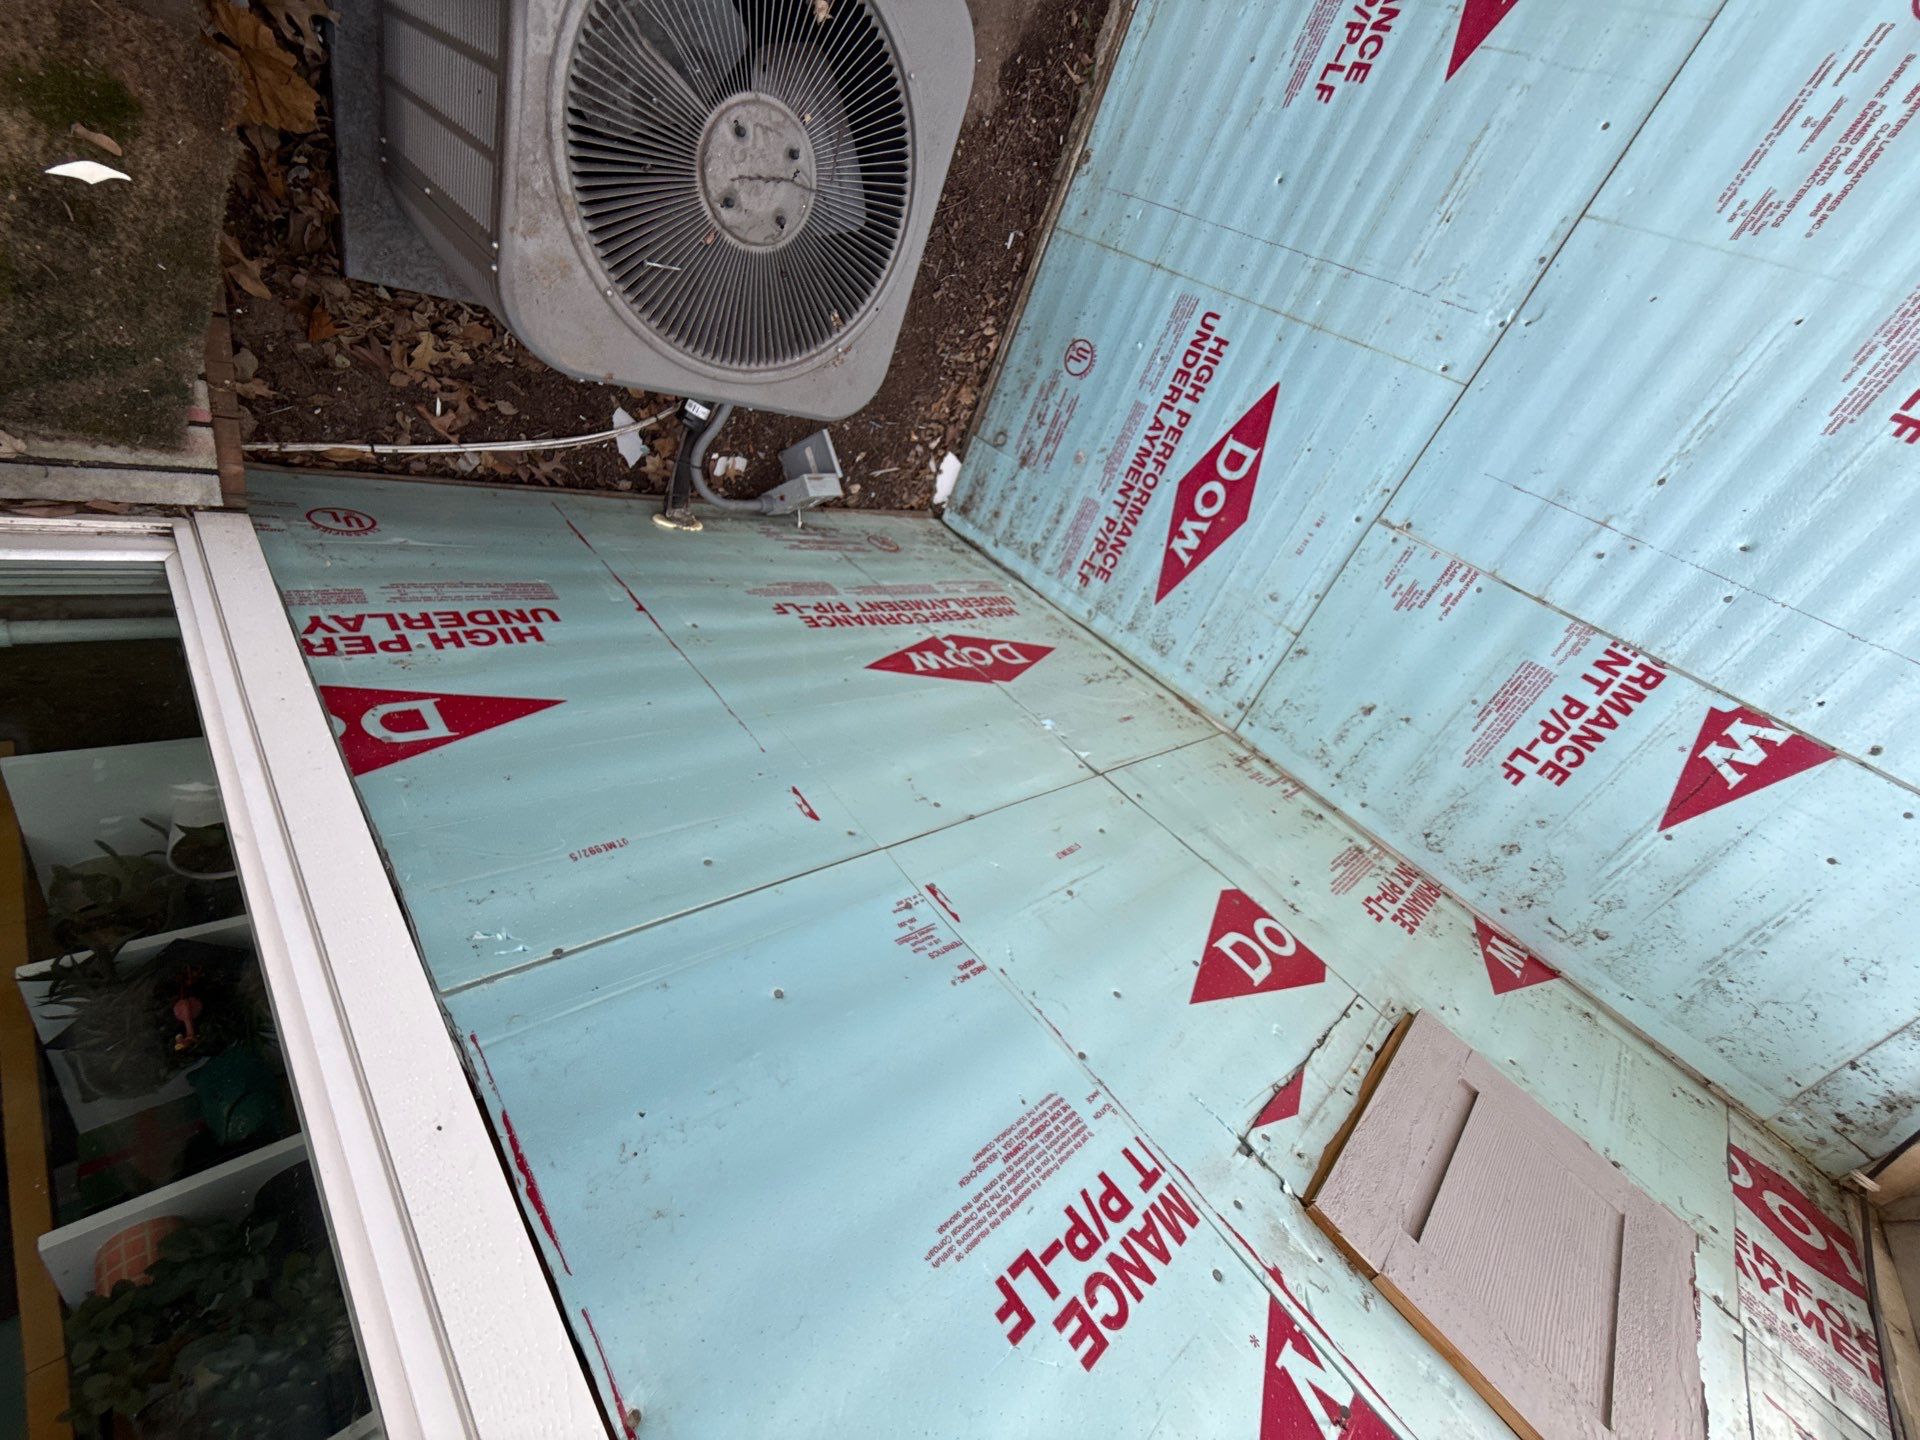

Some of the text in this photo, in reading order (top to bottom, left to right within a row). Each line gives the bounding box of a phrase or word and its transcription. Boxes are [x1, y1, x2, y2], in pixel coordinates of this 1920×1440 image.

[1344, 0, 1401, 83] NCE
[1814, 104, 1888, 186] FOAMED PLASTIC
[1841, 123, 1892, 175] CLASSIFIED
[1769, 145, 1843, 228] CHARACTERISTICS
[1183, 335, 1229, 403] HIGH
[1111, 310, 1220, 511] UNDERLAYMENT
[1889, 388, 1920, 444] F
[1093, 408, 1192, 583] PERFORMANCE
[1169, 433, 1262, 569] DOW
[1074, 515, 1119, 587] P/P-LF
[300, 607, 562, 636] UNDERLAY
[300, 625, 545, 657] HIGH PER
[771, 601, 853, 616] P/P-LF
[977, 605, 1020, 619] HIGH
[1500, 693, 1590, 788] P/P-LF
[1536, 655, 1669, 787] RMANCE
[1212, 917, 1297, 987] DO
[975, 1197, 991, 1215] Dow
[987, 1188, 1001, 1203] The
[994, 1171, 1135, 1347] P/P-LF
[1053, 1180, 1203, 1372] MANCE
